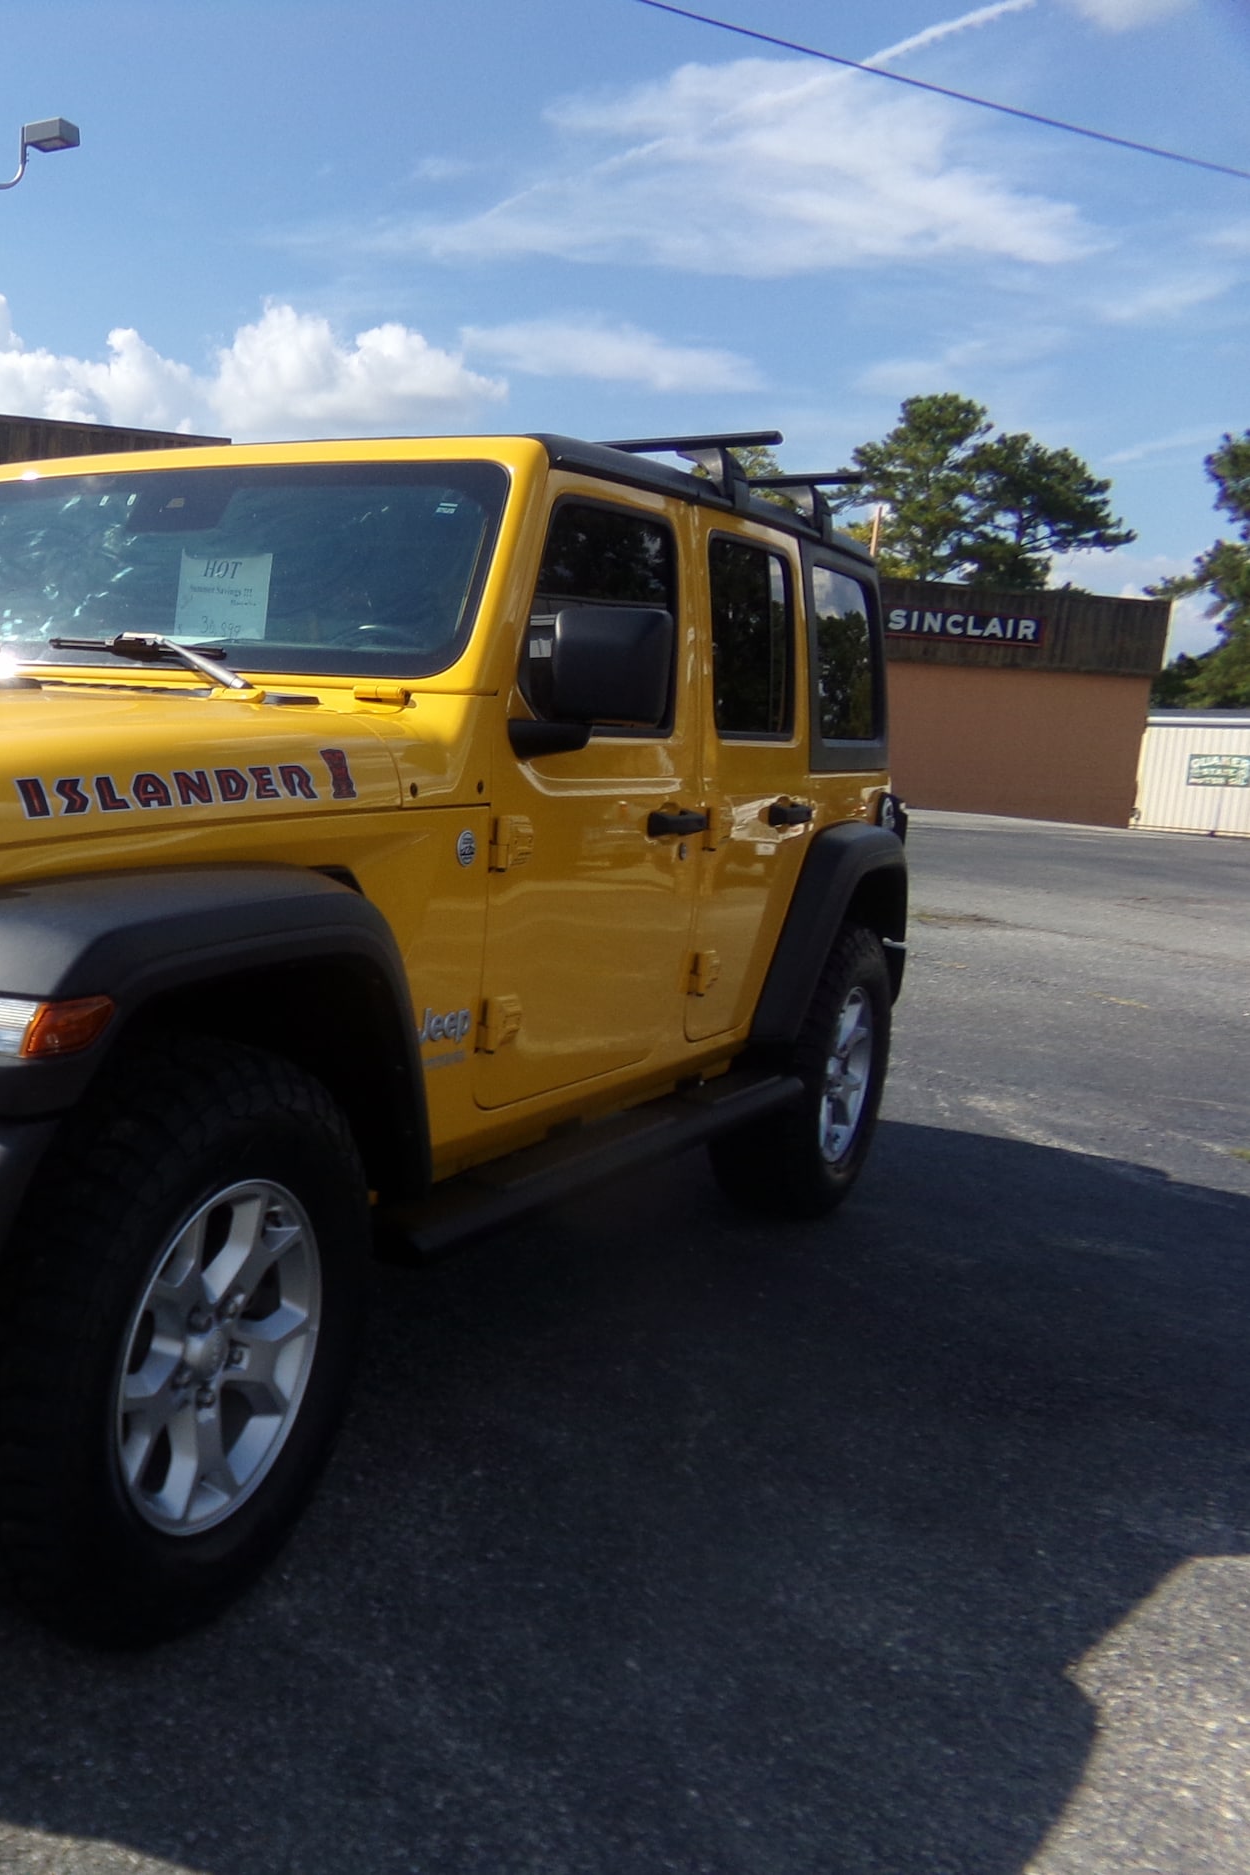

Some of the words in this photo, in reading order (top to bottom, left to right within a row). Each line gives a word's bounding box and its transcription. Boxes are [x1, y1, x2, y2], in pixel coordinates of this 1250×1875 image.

[203, 560, 242, 580] HOT
[887, 608, 1037, 641] SINCLAIR
[13, 763, 320, 819] ISLANDER
[417, 1007, 472, 1044] Jeep
